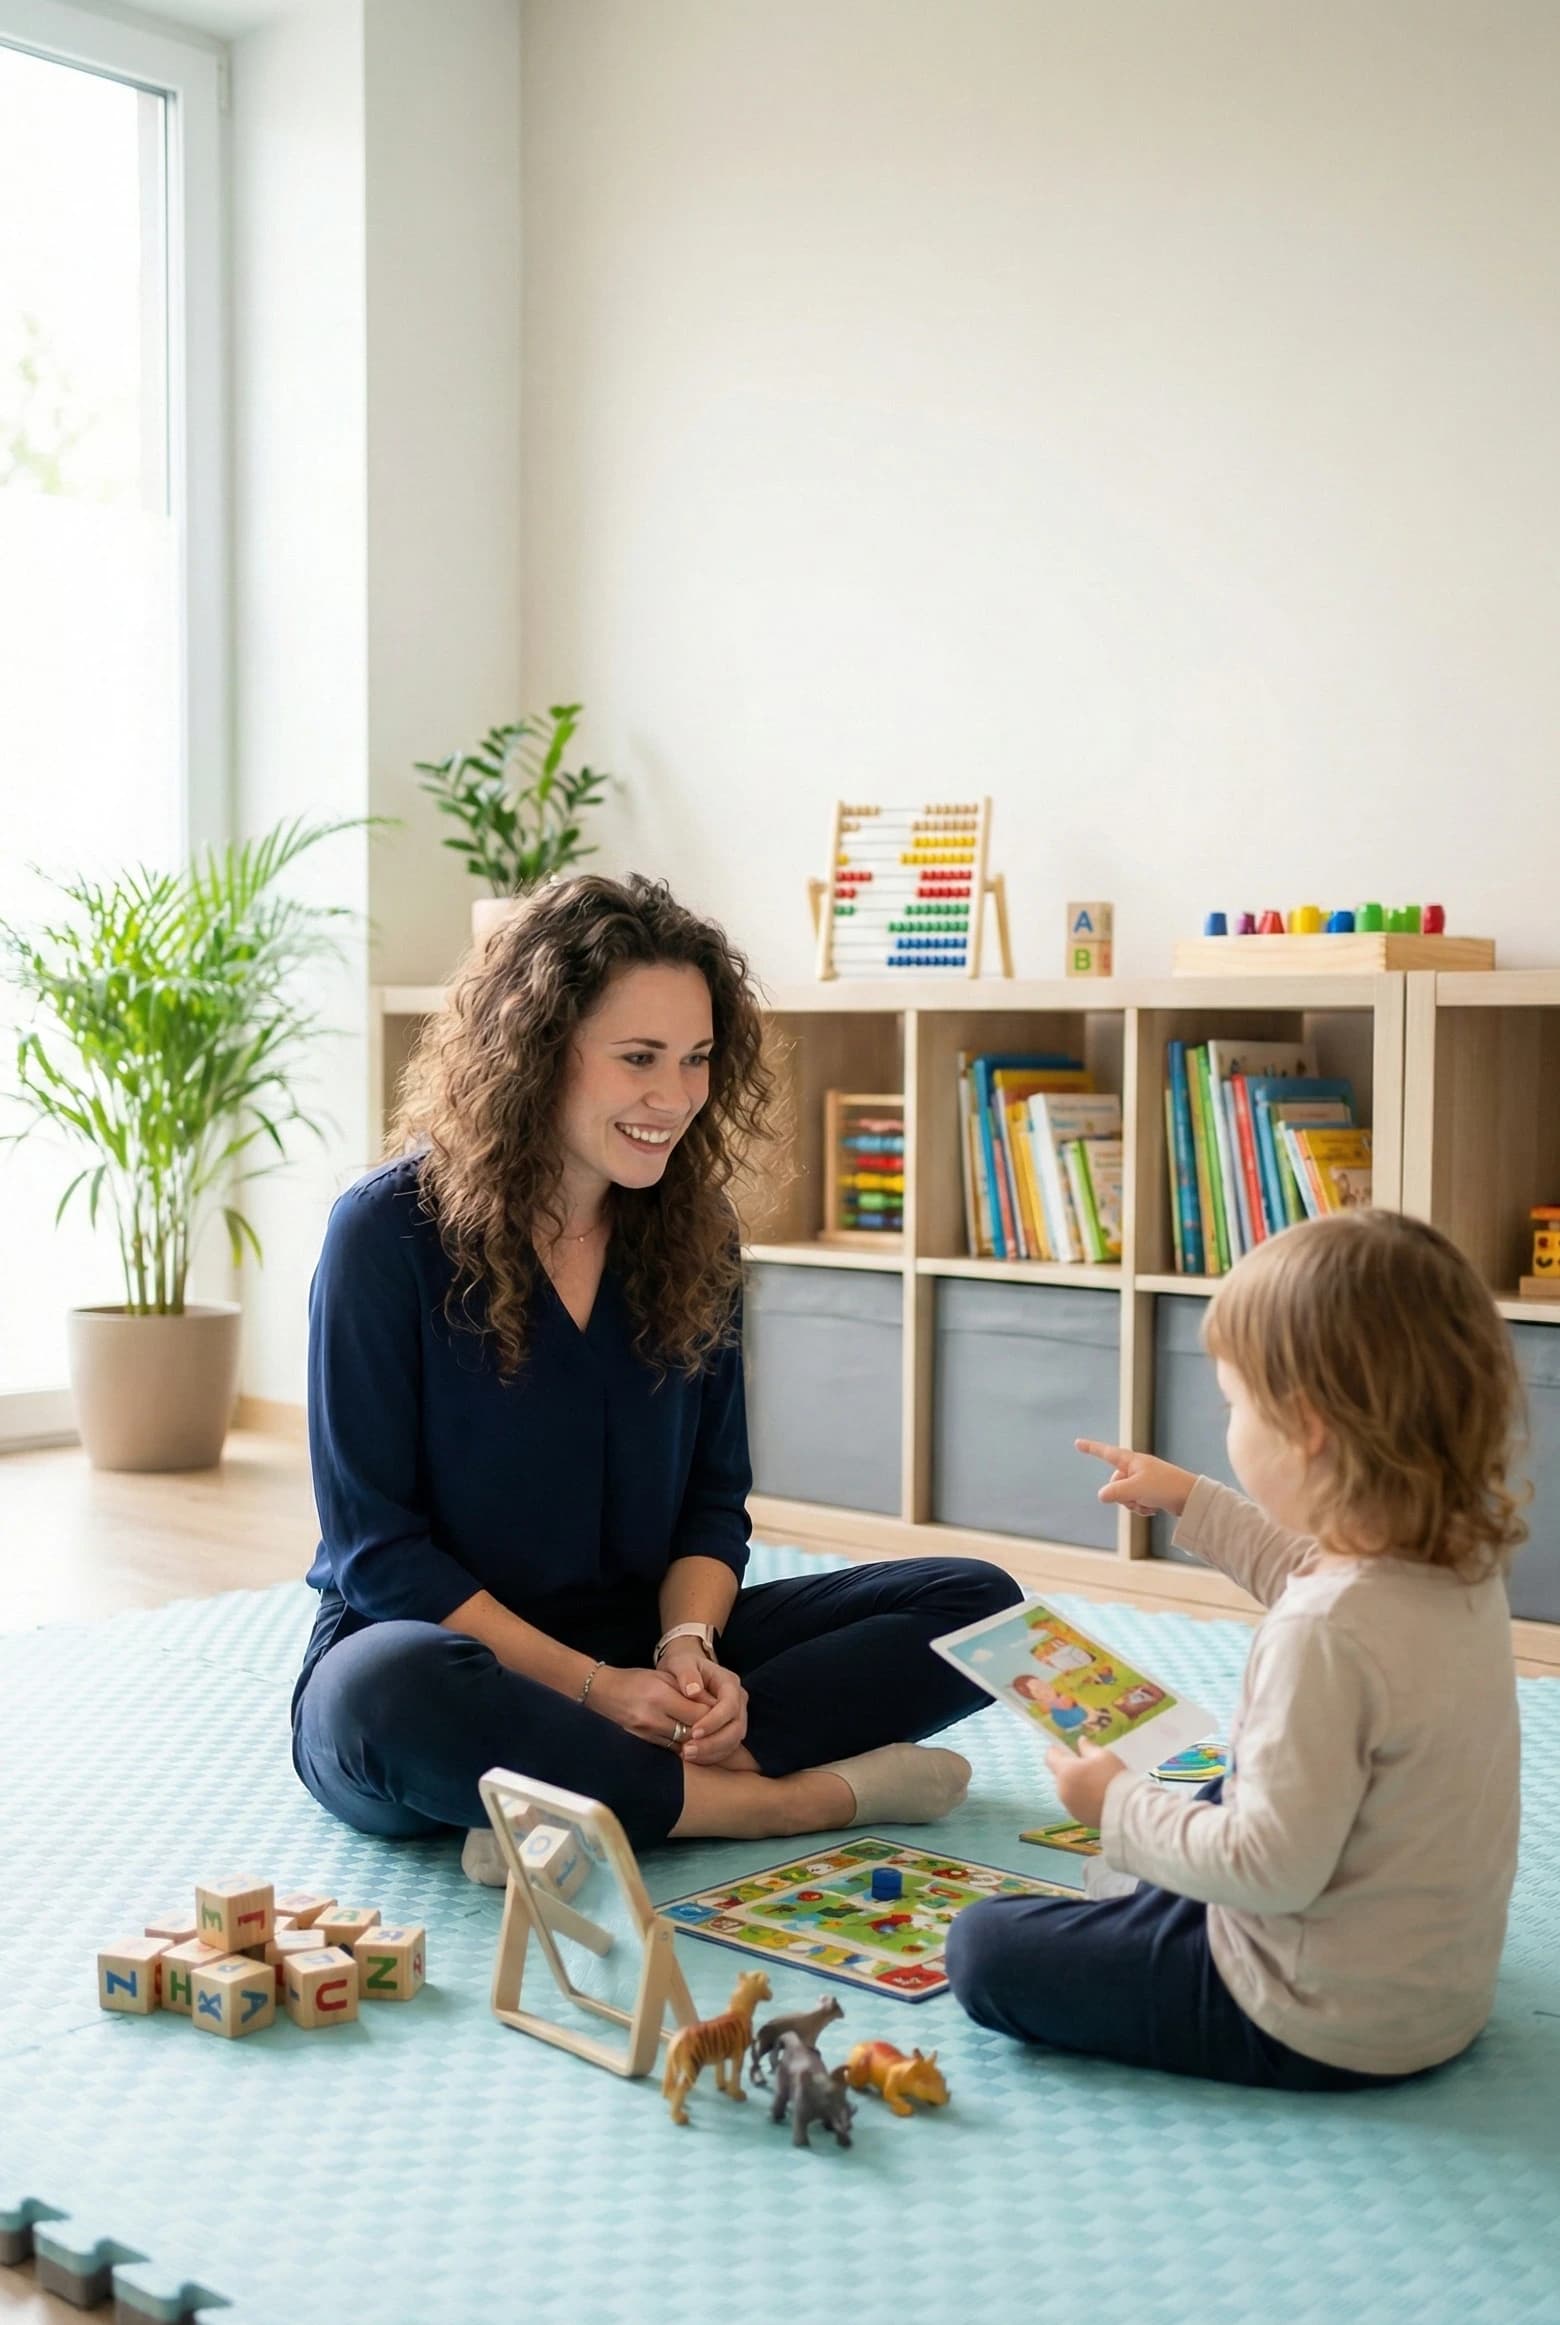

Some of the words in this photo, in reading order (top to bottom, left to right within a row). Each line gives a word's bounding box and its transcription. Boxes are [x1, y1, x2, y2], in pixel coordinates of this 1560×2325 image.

[1073, 910, 1093, 933] A
[1074, 949, 1091, 971] B
[170, 1970, 192, 2006] H
[366, 1956, 398, 1990] Z
[241, 1990, 268, 2024] A
[316, 1978, 348, 2012] U
